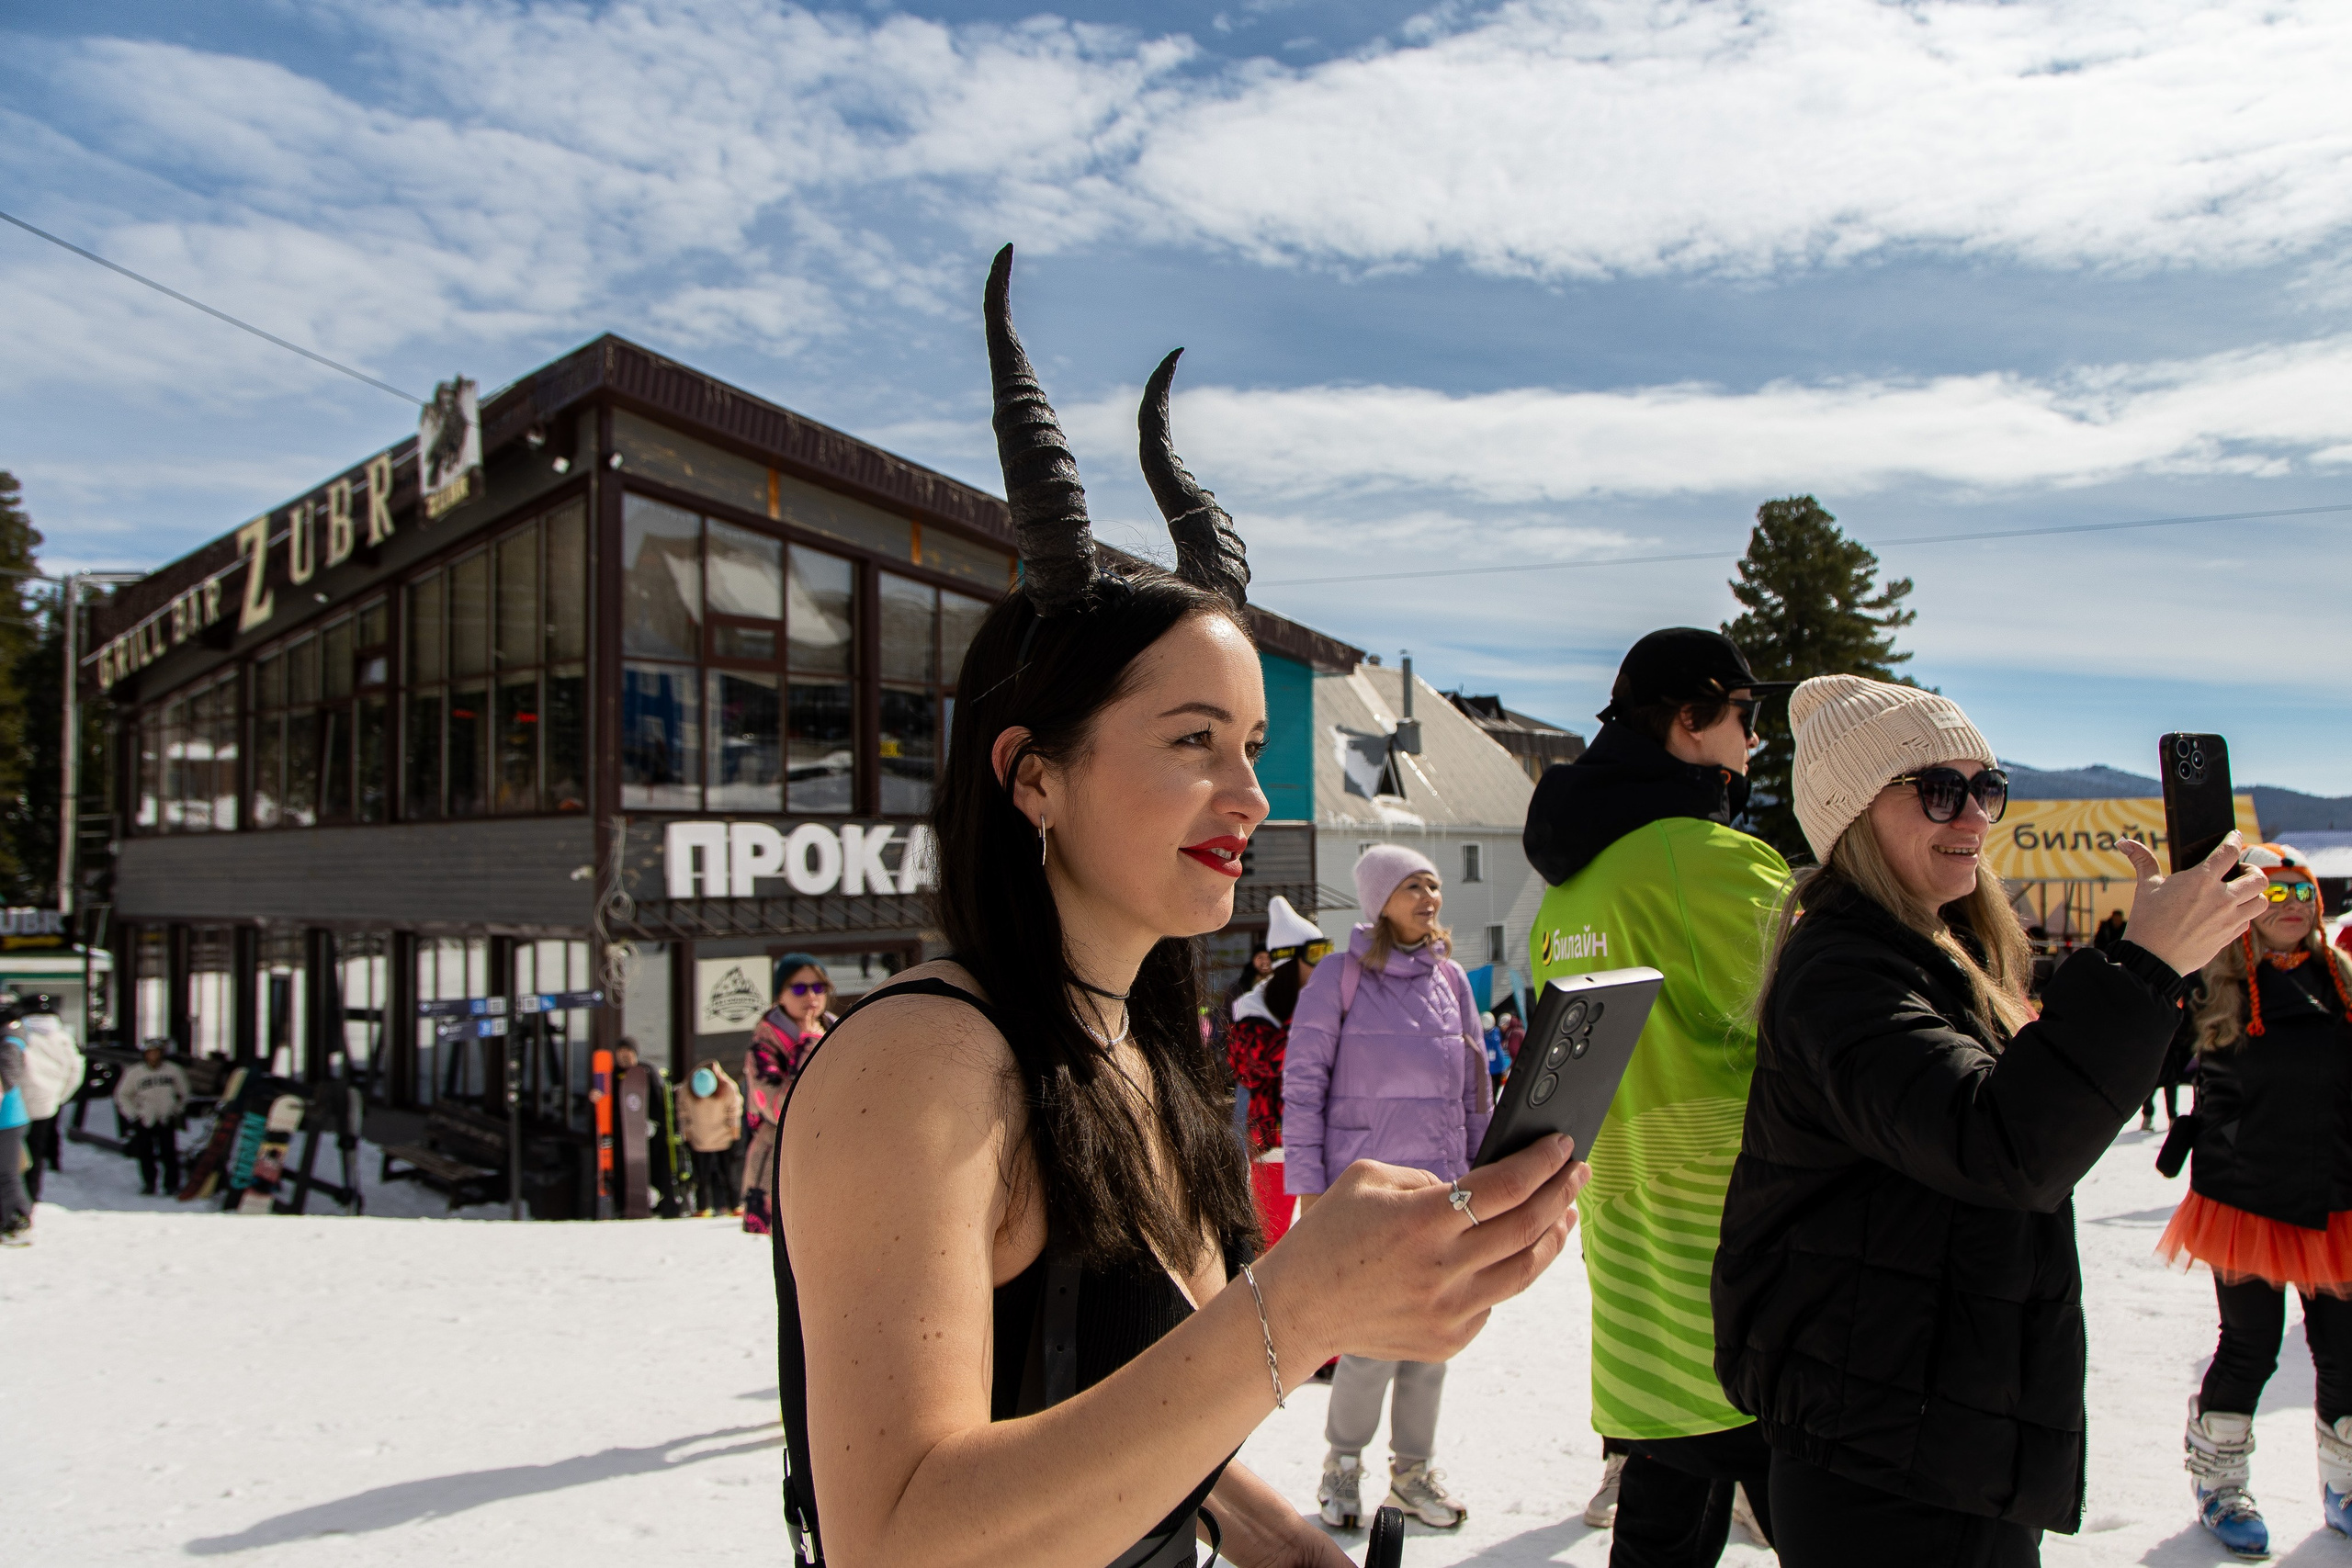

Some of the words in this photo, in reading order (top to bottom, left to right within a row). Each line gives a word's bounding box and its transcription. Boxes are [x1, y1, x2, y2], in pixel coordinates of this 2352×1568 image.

[98, 617, 167, 692] GRILL
[172, 578, 221, 643] BAR
[236, 453, 396, 634] ZUBR
[1554, 924, 1608, 963] билайн
